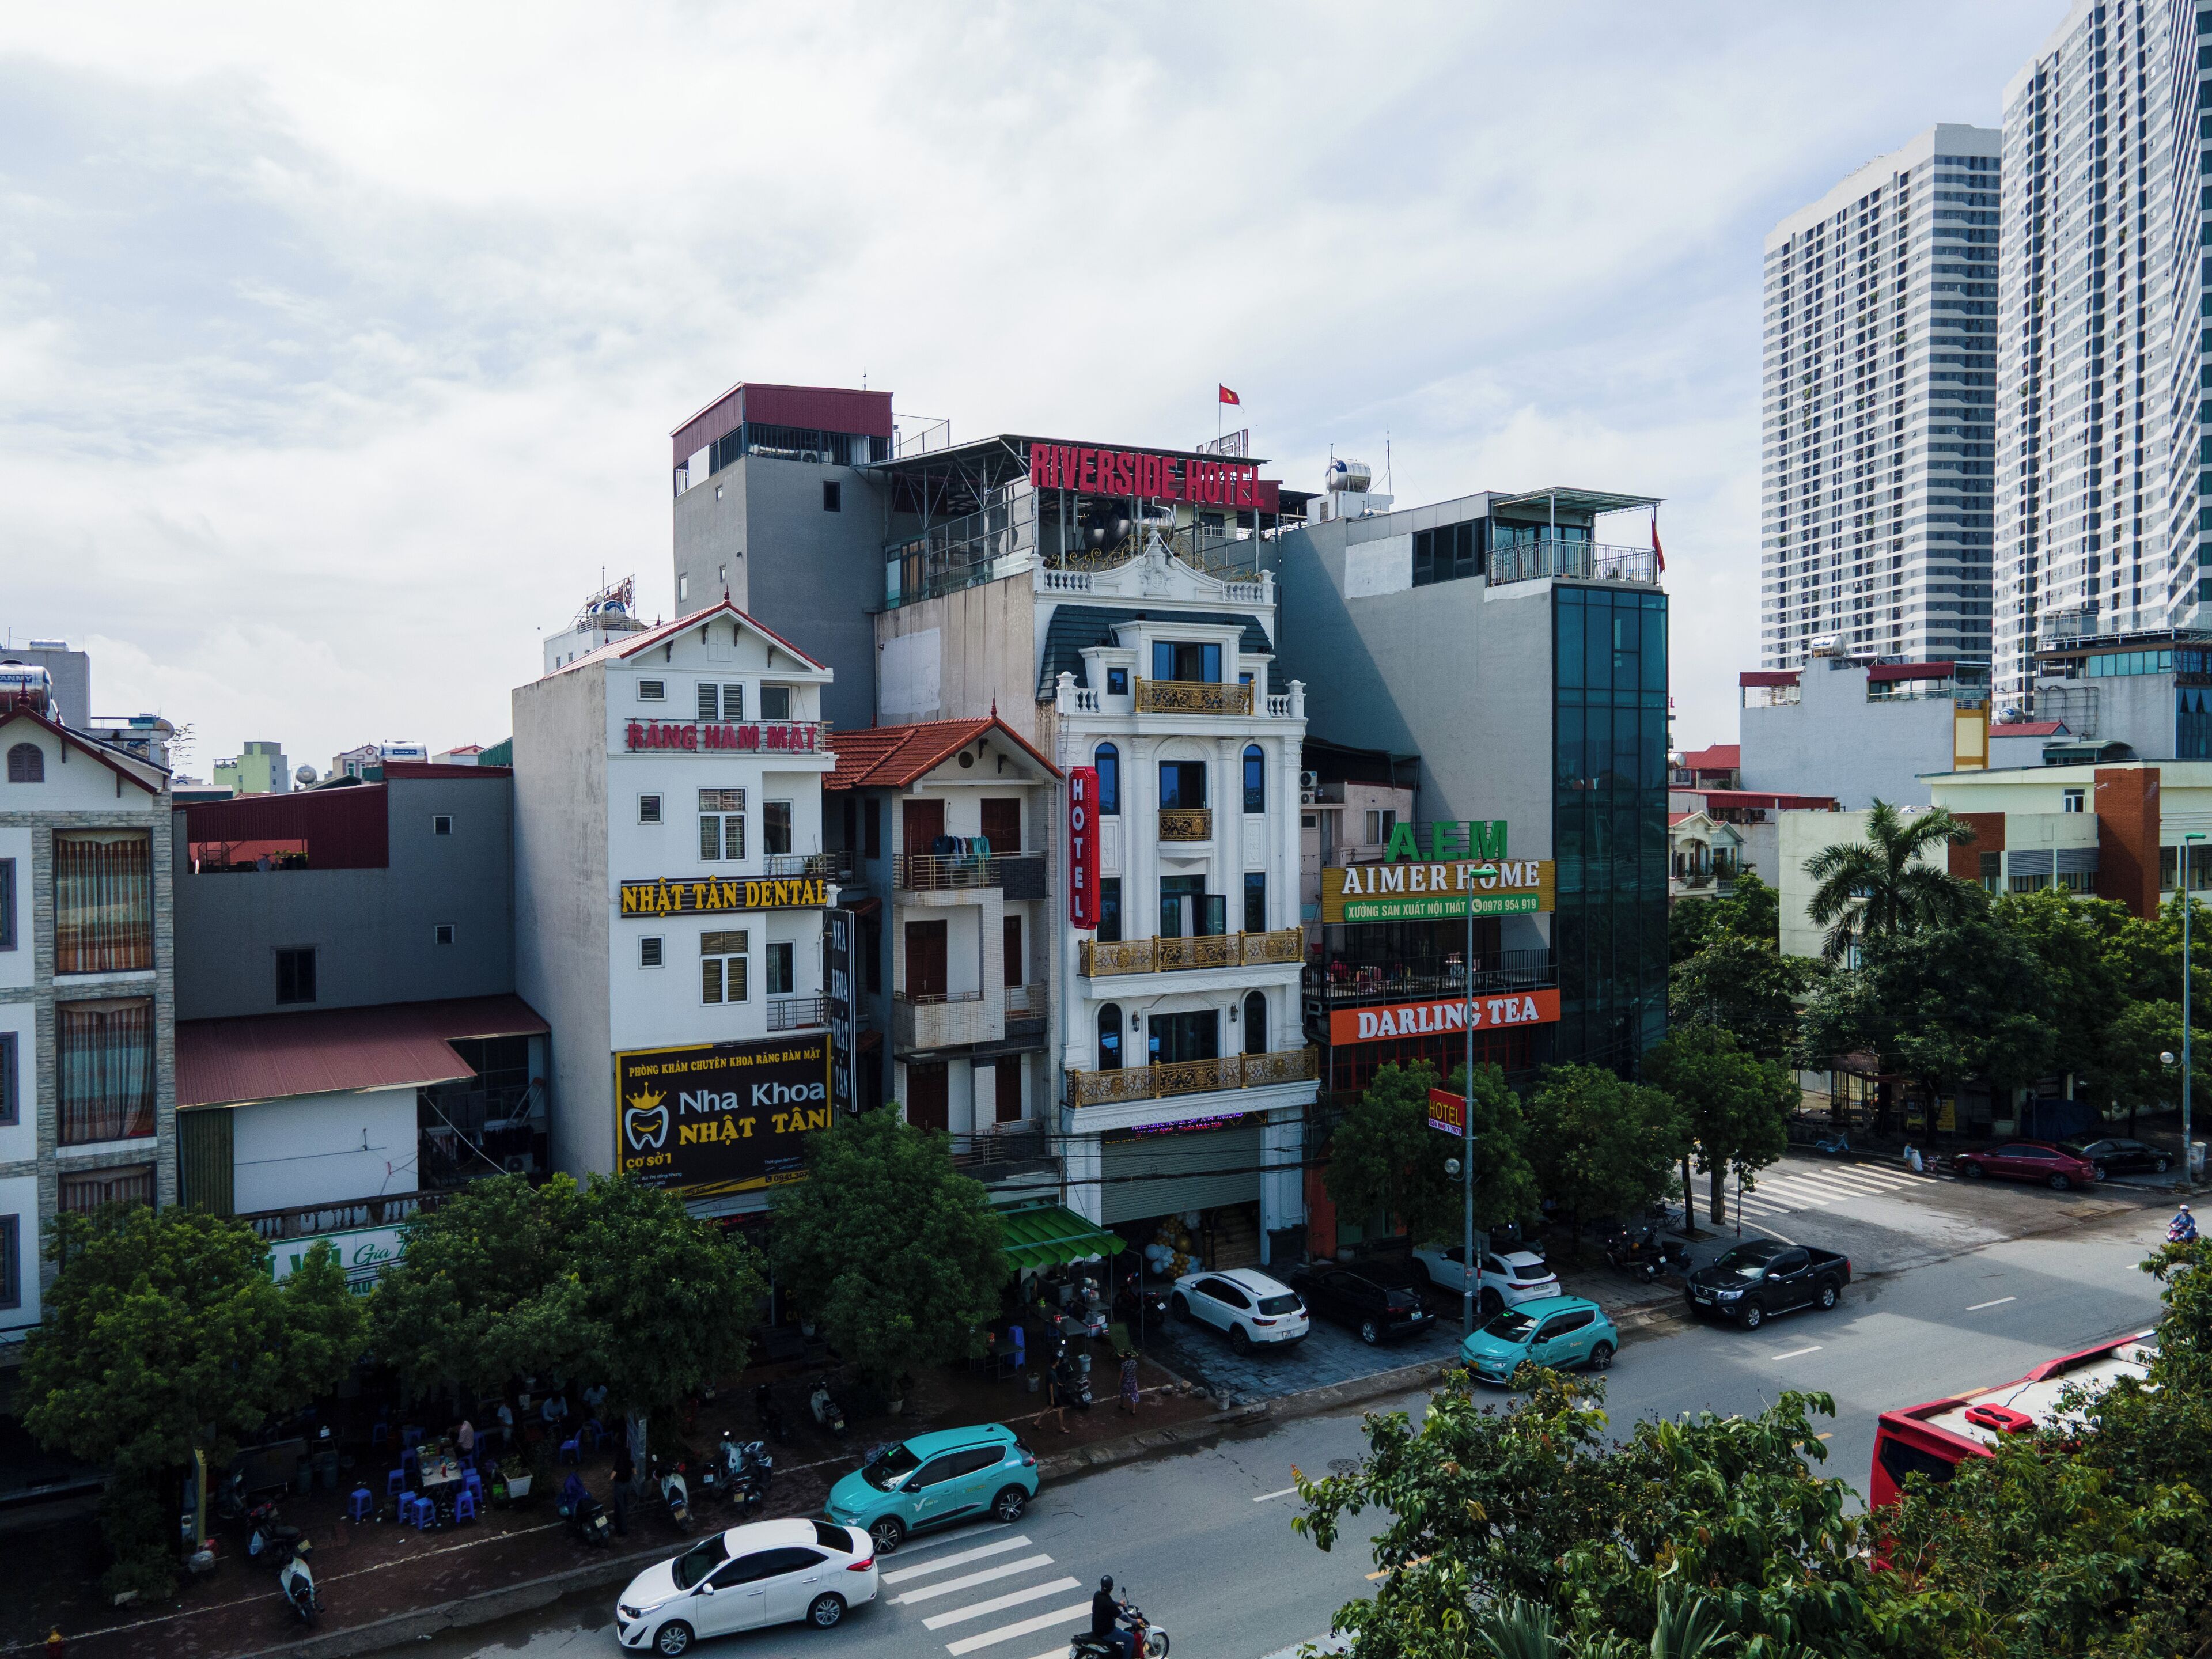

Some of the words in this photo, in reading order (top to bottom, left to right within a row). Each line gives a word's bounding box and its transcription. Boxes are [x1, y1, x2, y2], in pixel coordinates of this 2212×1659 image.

[1031, 442, 1177, 499] RIVERSIDE
[1185, 459, 1264, 507] HOTEL
[627, 718, 697, 749] RĂNG
[705, 719, 759, 749] HÀM
[767, 721, 817, 755] MẶT
[1072, 779, 1085, 918] HOTEL
[1384, 820, 1508, 863] A.E.M
[1342, 865, 1449, 895] AIMER
[1456, 861, 1540, 891] HOME
[622, 876, 685, 918] NHẬT
[692, 874, 738, 909] TÂN
[745, 879, 828, 907] DENTAL
[1348, 901, 1379, 918] XƯỞNG
[1381, 900, 1400, 916] SẢN
[1402, 898, 1425, 916] XUẤT
[1427, 900, 1443, 917] NỘI
[1445, 897, 1466, 914] THẤT
[1483, 900, 1502, 911] 0978
[1505, 899, 1520, 911] 954
[1521, 898, 1536, 910] 919
[832, 919, 846, 953] NHA
[832, 968, 849, 1003] KHOA
[1357, 1001, 1482, 1039] DARLING
[1487, 995, 1540, 1025] TEA
[629, 1064, 659, 1077] PHÒNG
[662, 1060, 688, 1074] KHÁM
[691, 1056, 726, 1071] CHUYÊN
[729, 1055, 753, 1067] KHOA
[756, 1051, 781, 1065] RĂNG
[782, 1049, 801, 1062] HÀM
[804, 1047, 821, 1060] MẶT
[835, 1058, 849, 1099] TÂN
[679, 1089, 738, 1115] Nha
[751, 1082, 826, 1107] Khoa
[1429, 1100, 1461, 1126] HOTEL
[679, 1115, 756, 1145] NHẬT
[771, 1107, 826, 1134] TÂN
[626, 1154, 646, 1168] CƠ
[647, 1152, 664, 1166] SỞ
[665, 1153, 672, 1164] 1
[353, 1243, 392, 1266] Gia
